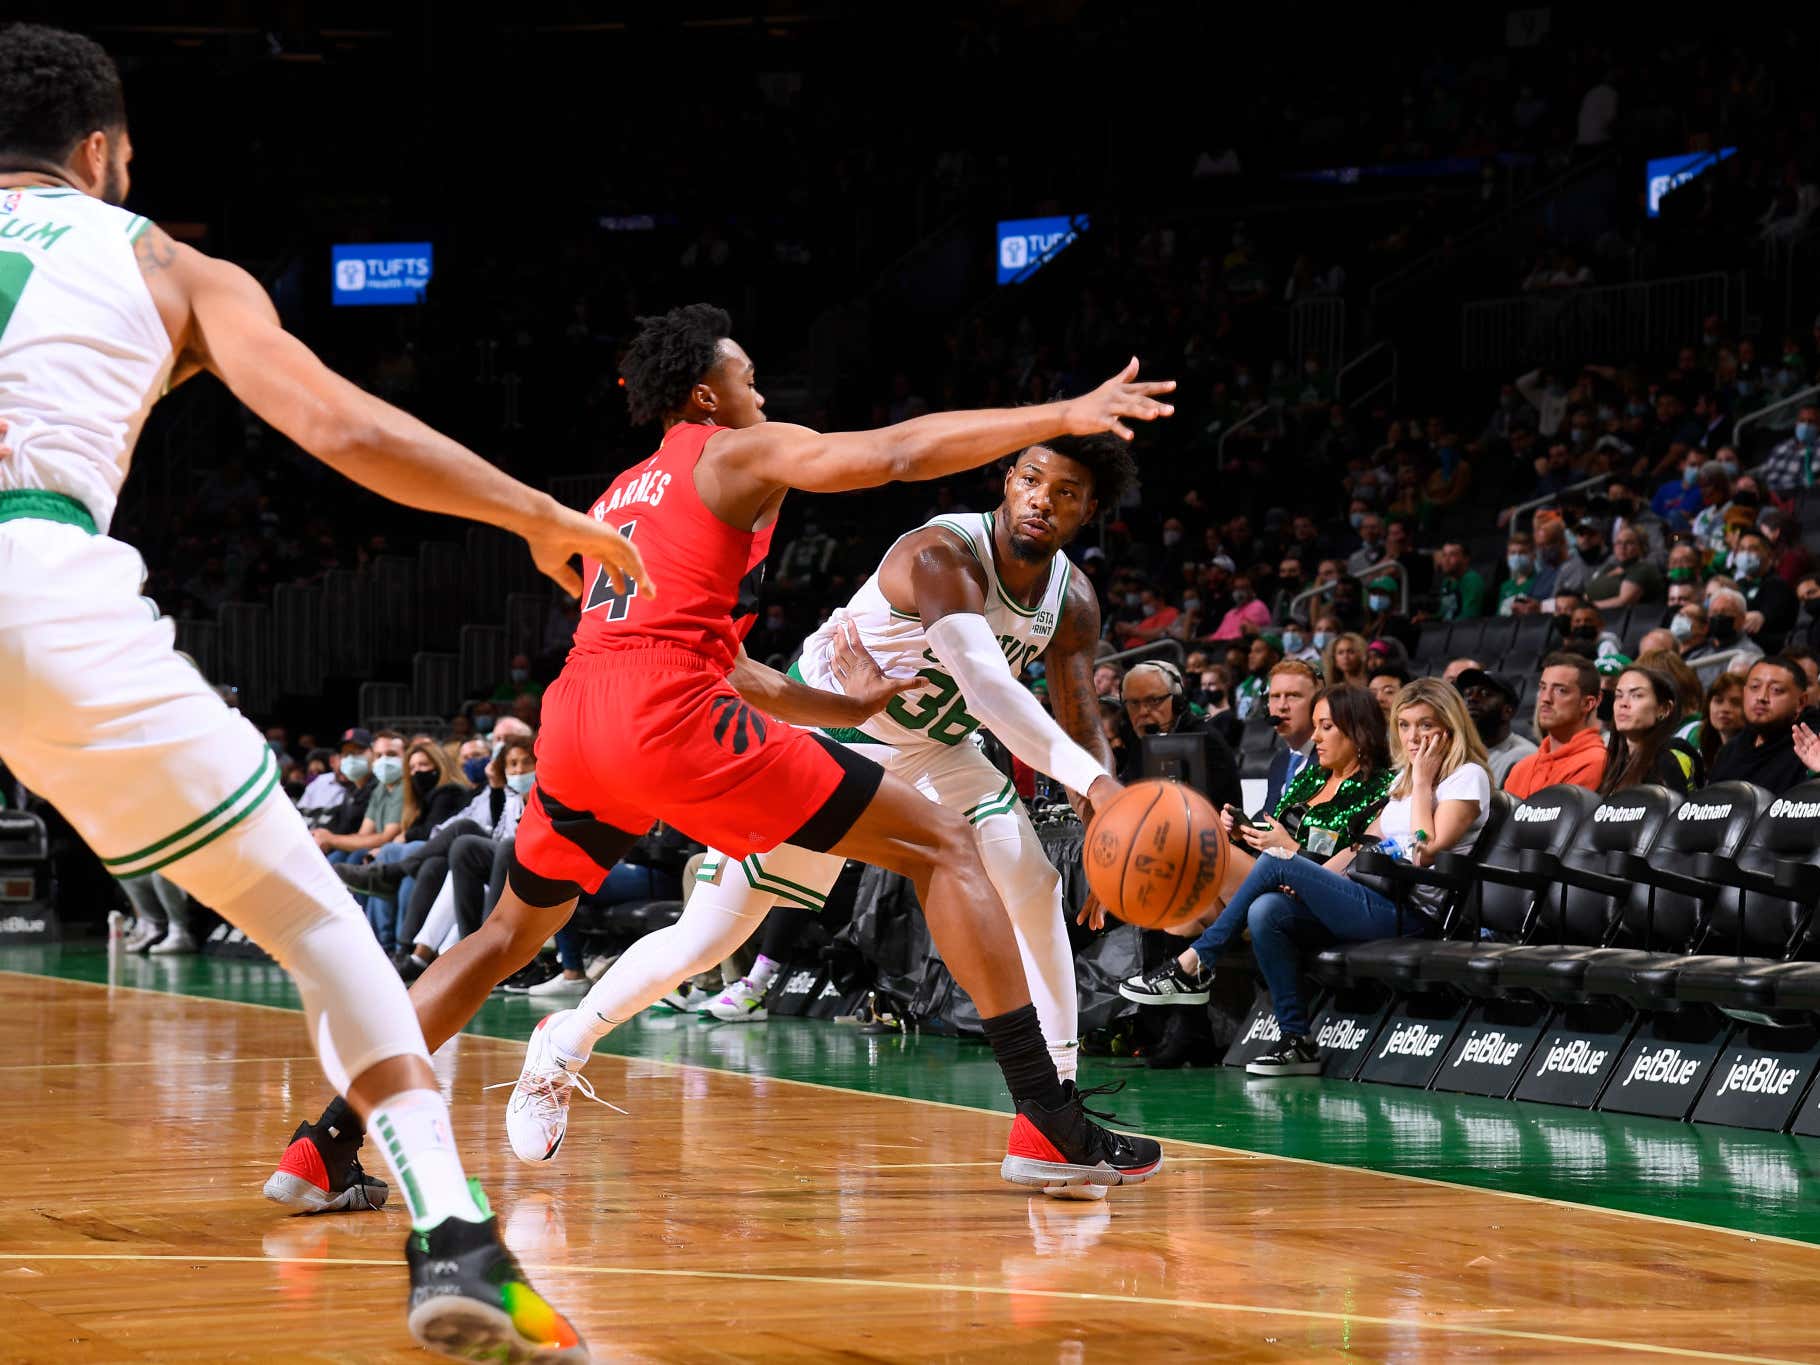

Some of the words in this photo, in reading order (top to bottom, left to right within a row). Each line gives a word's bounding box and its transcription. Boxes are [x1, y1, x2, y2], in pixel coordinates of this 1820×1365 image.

[367, 258, 429, 276] TUFTS
[594, 470, 672, 521] BARNES
[582, 520, 637, 622] 4
[1032, 624, 1052, 636] RINT
[1036, 610, 1054, 627] ISTA
[886, 668, 982, 746] 36
[1522, 804, 1561, 822] Putnam
[1602, 805, 1646, 822] Putnam
[1686, 803, 1733, 820] Putnam
[1316, 1017, 1366, 1050] jetBlue
[1379, 1023, 1440, 1059] jetBlue
[1453, 1030, 1521, 1067] jetBlue
[1537, 1038, 1607, 1077] jetBlue
[1623, 1046, 1700, 1086] jetBlue
[1717, 1054, 1798, 1096] jetBlue
